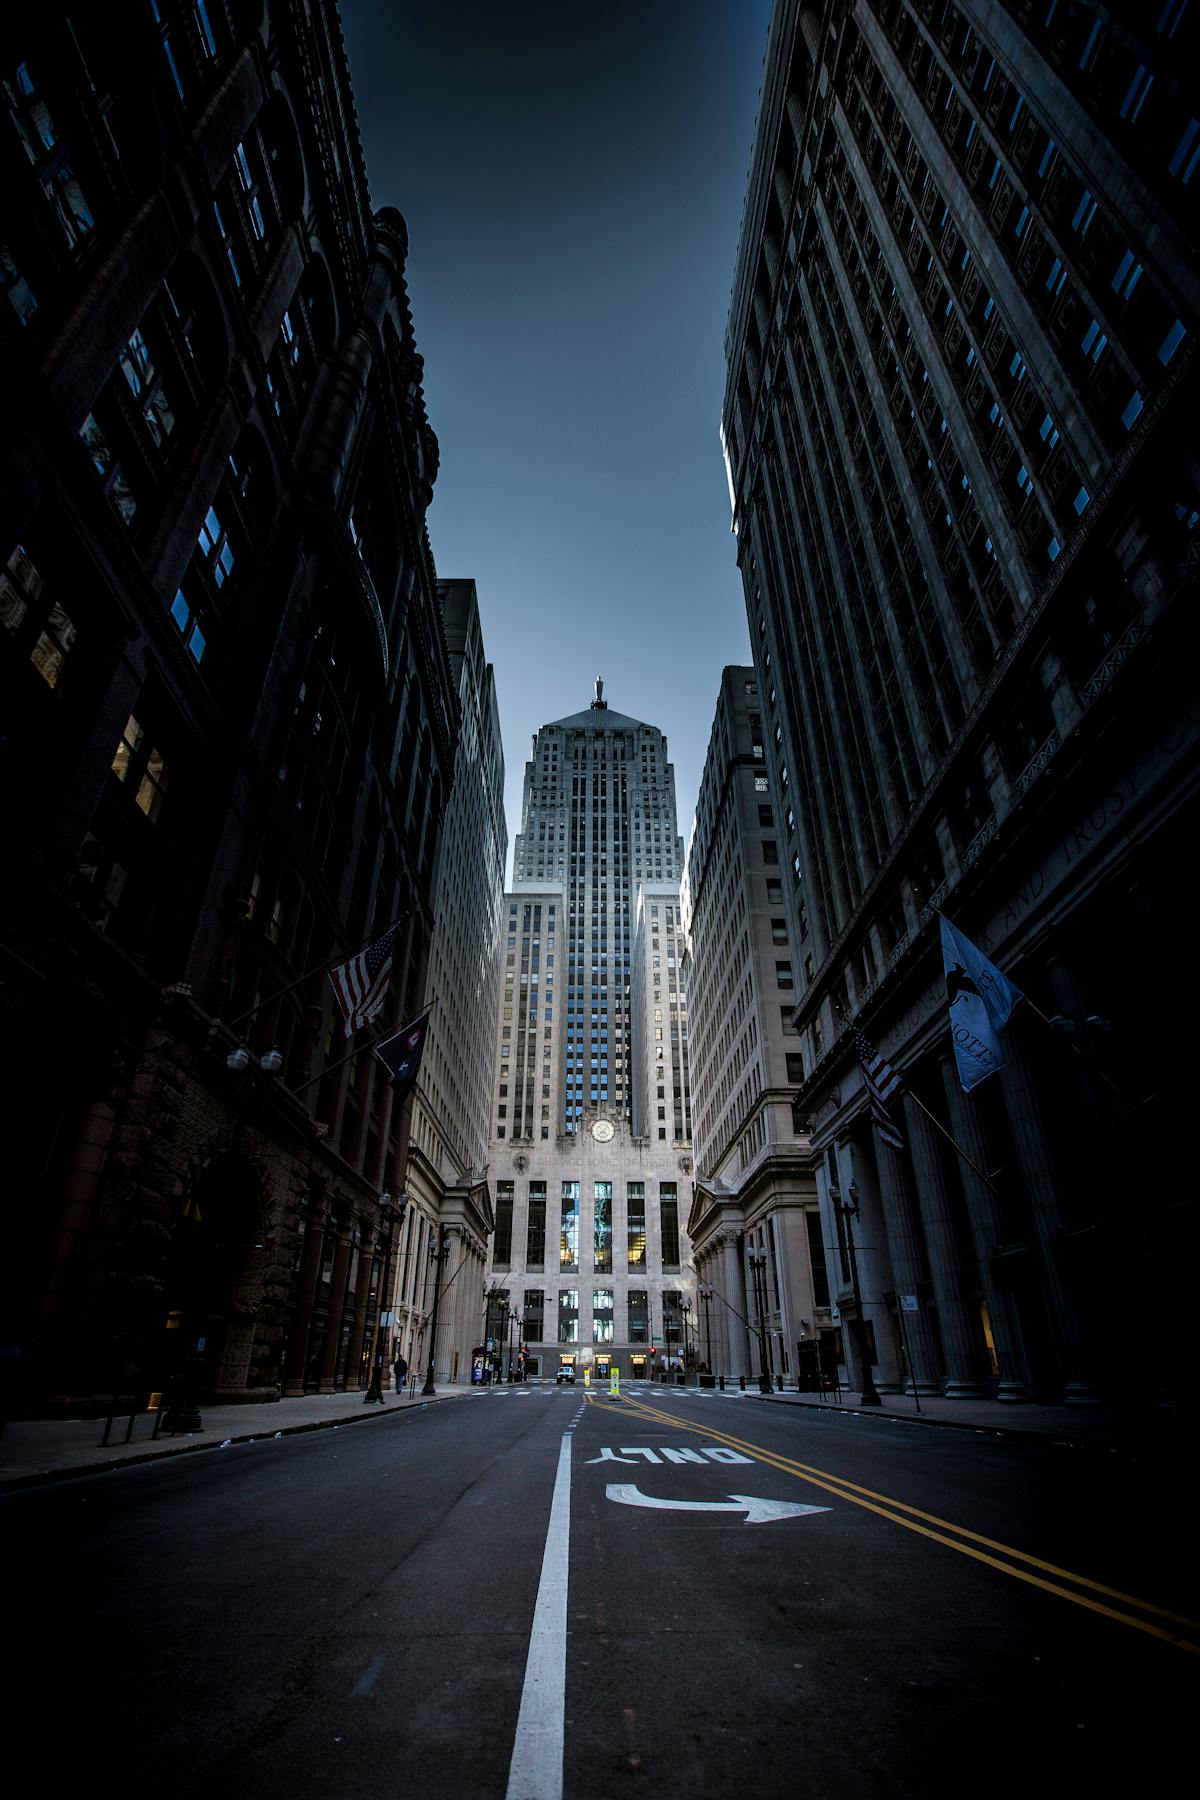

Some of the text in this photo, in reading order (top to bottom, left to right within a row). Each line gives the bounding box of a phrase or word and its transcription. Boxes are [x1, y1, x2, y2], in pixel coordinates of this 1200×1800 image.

[1004, 869, 1045, 930] AND
[586, 1157, 620, 1168] BOARD
[624, 1157, 637, 1168] OF
[584, 1447, 756, 1464] ONLY
